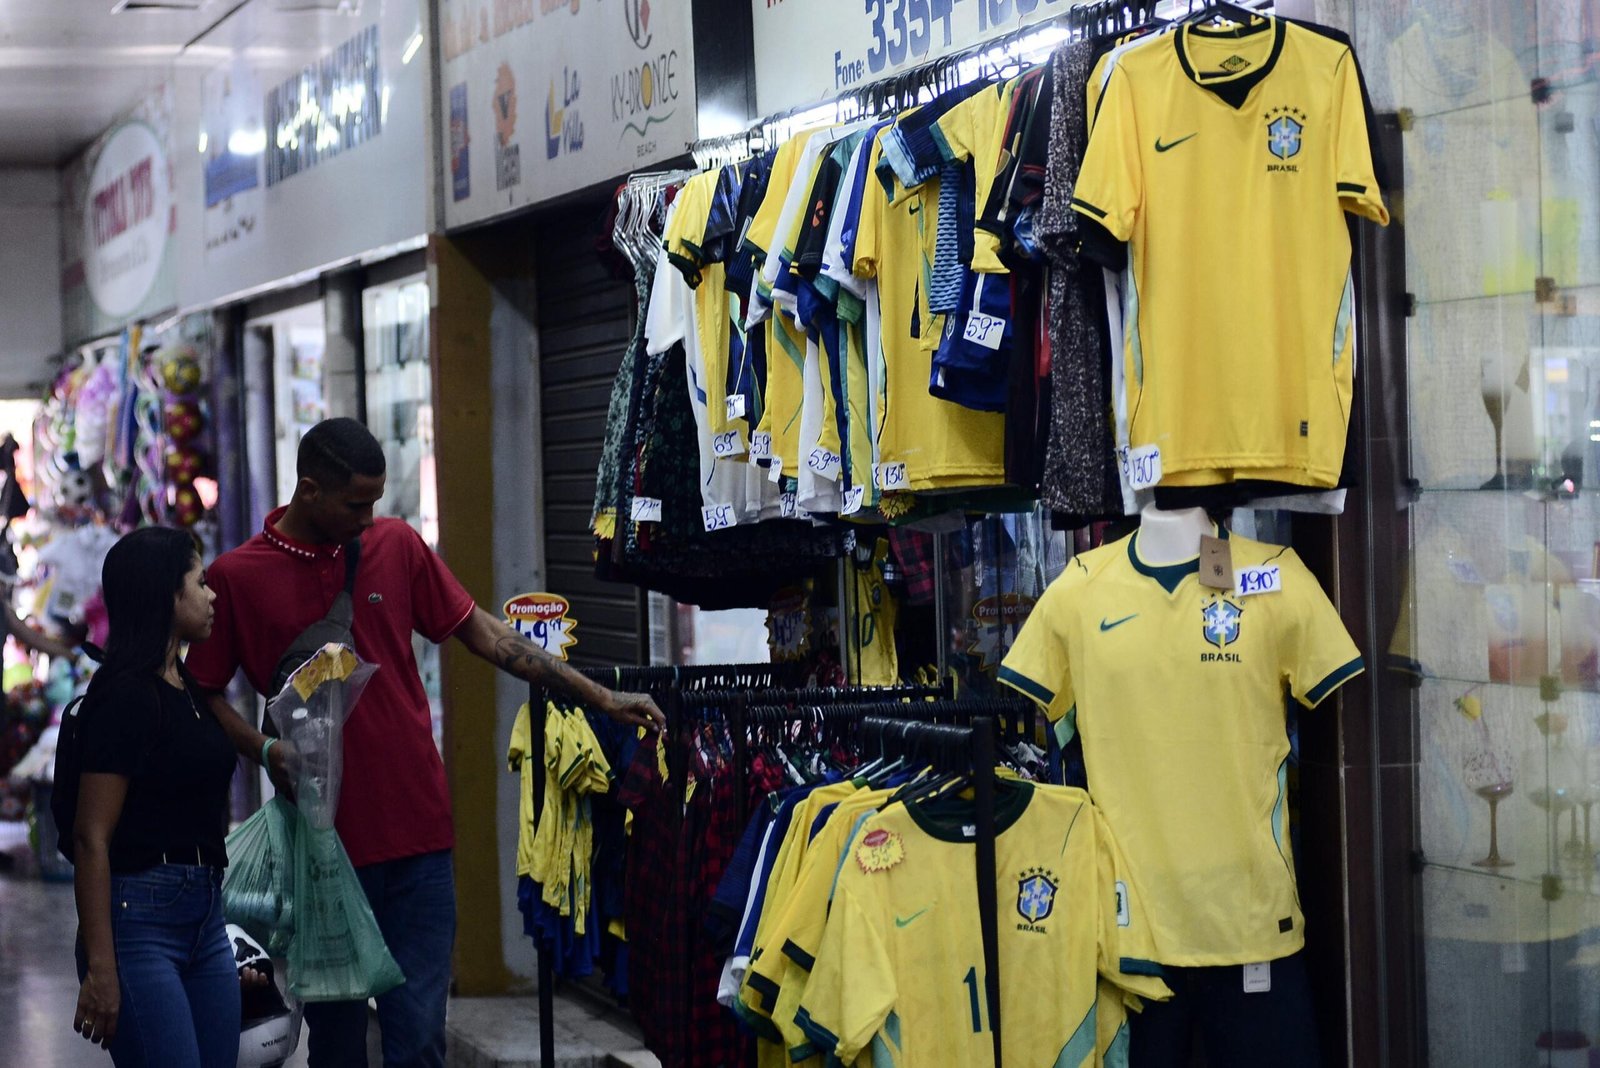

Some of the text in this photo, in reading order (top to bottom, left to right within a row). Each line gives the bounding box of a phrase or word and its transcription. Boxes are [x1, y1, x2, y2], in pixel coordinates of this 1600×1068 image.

[834, 50, 865, 90] Fone:
[1267, 164, 1299, 172] BRASIL
[509, 602, 563, 616] Promoção
[1200, 652, 1242, 663] BRASIL
[1016, 923, 1047, 935] BRASIL
